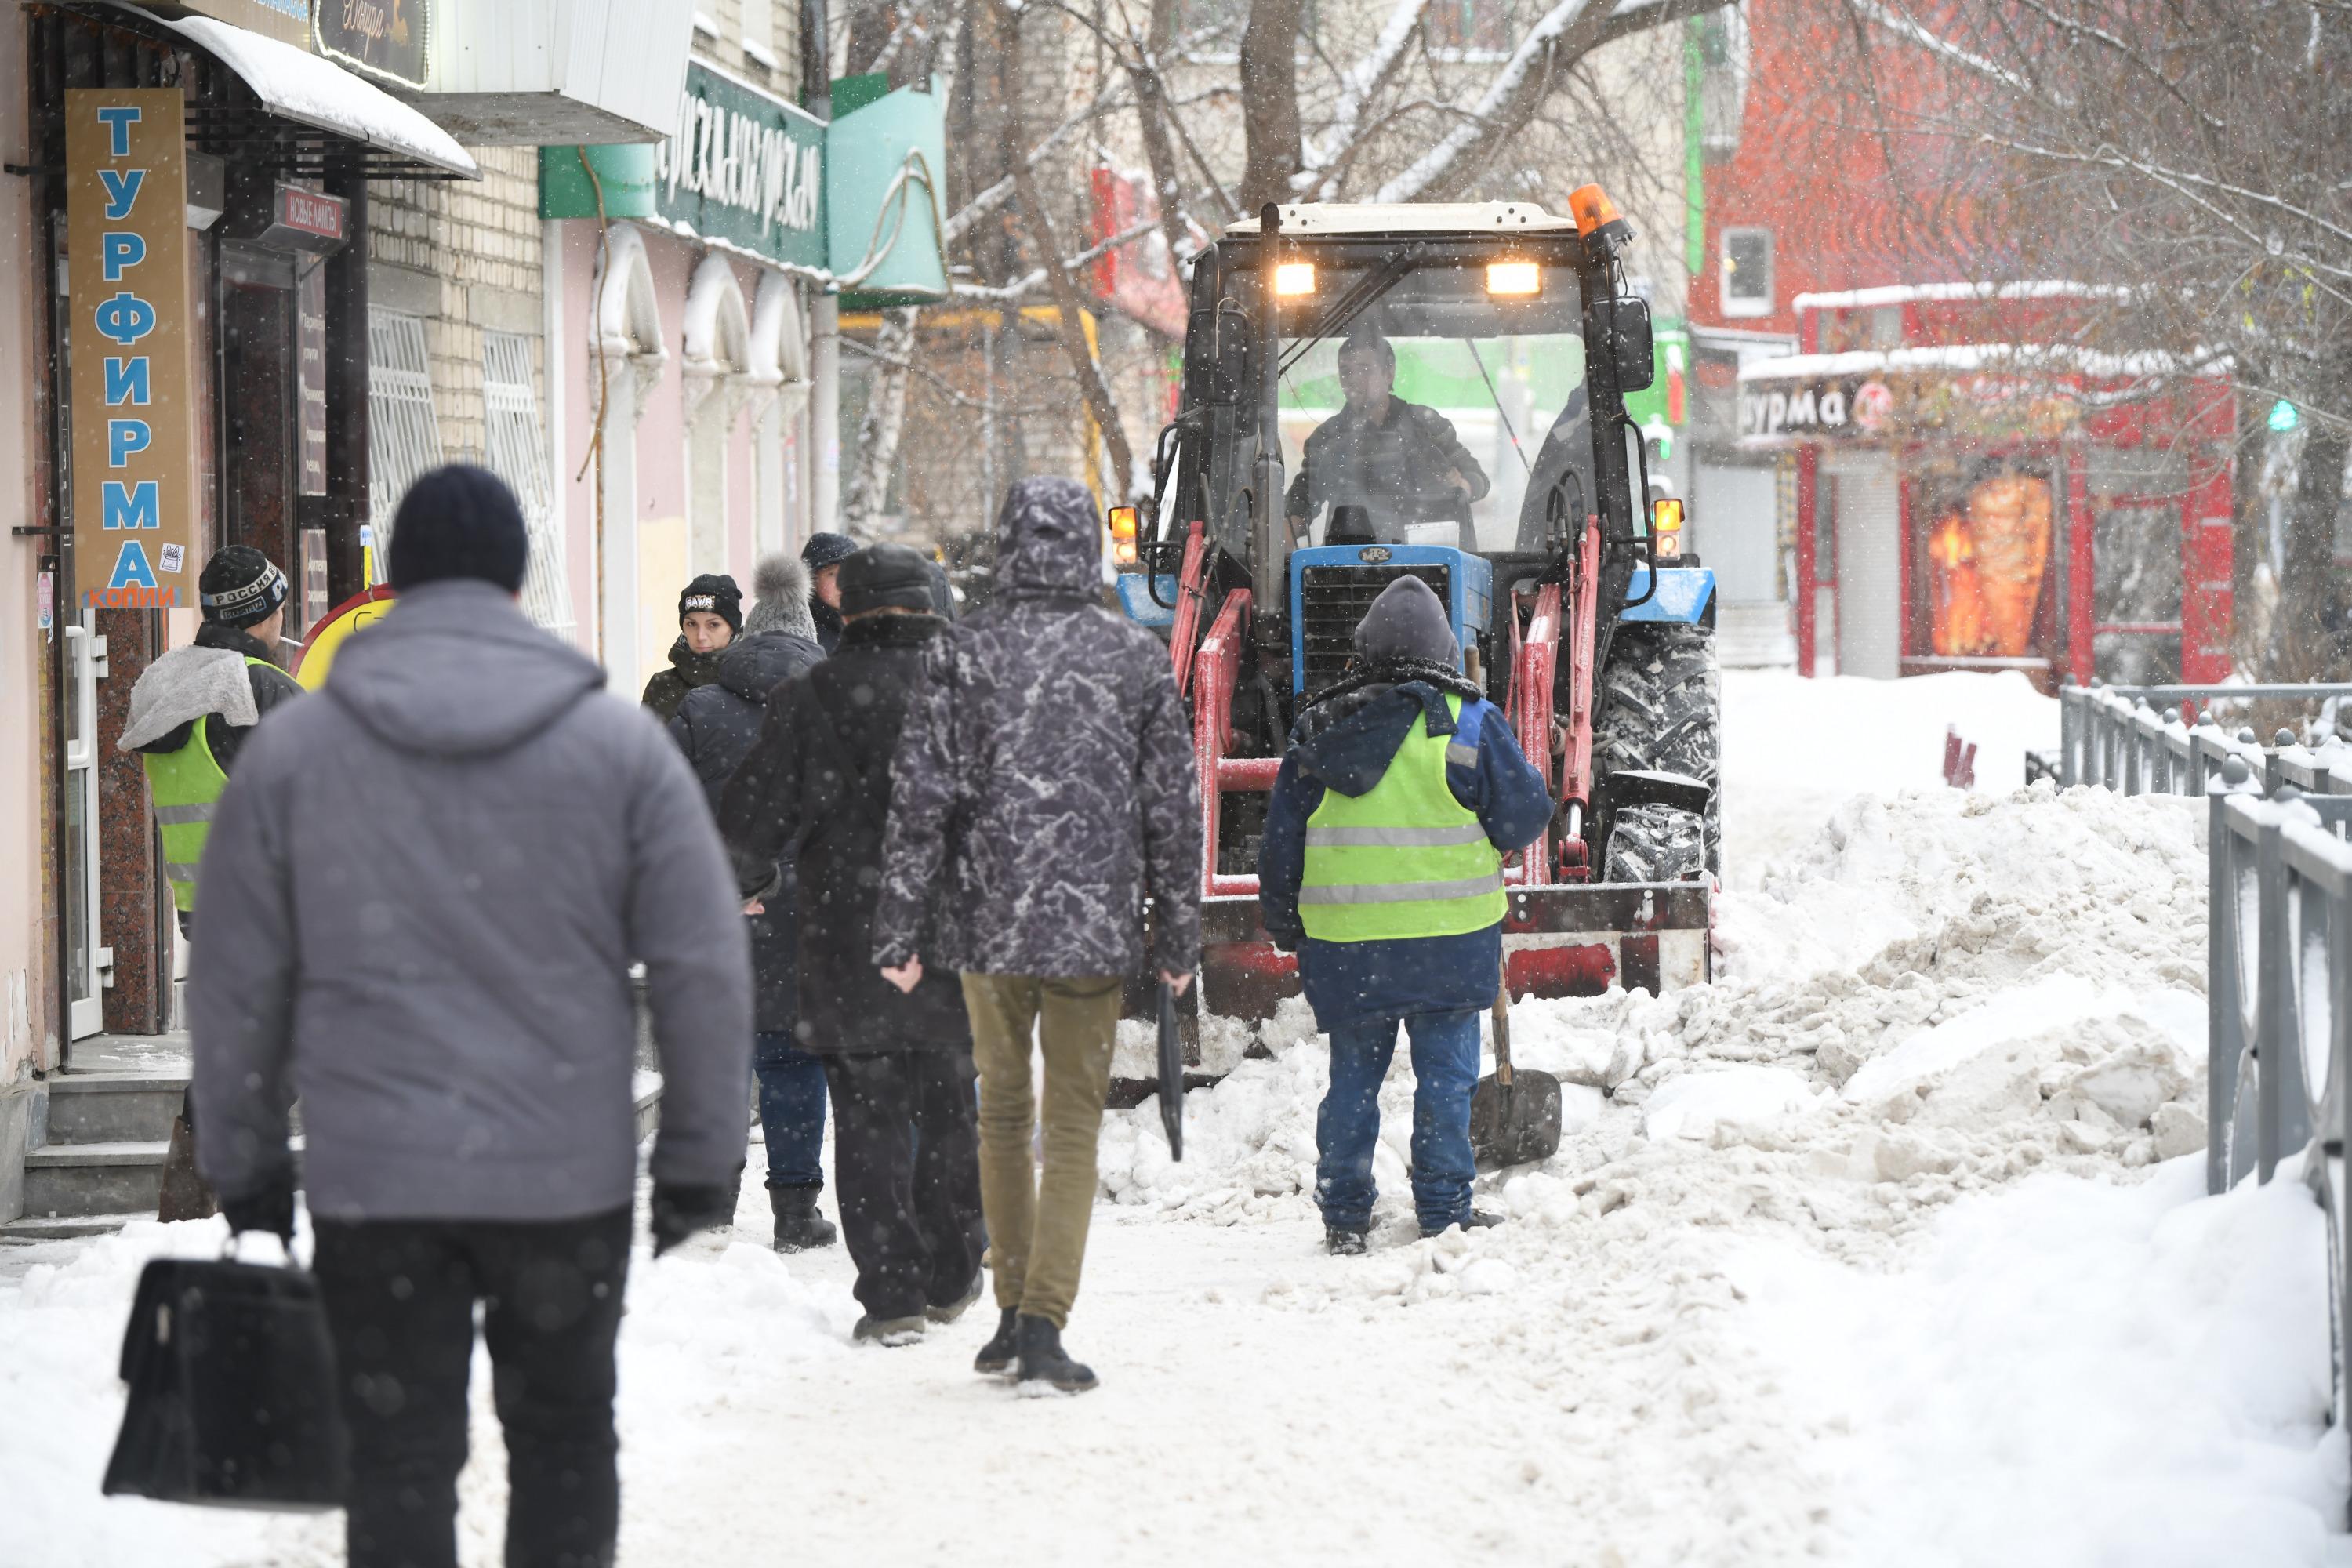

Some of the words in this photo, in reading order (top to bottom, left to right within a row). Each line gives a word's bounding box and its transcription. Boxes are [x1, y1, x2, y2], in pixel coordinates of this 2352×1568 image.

[95, 107, 160, 589] ТУРФИРМА
[89, 586, 175, 608] КОПИИ
[216, 573, 271, 604] РОССИЯ
[686, 597, 713, 607] RAWR
